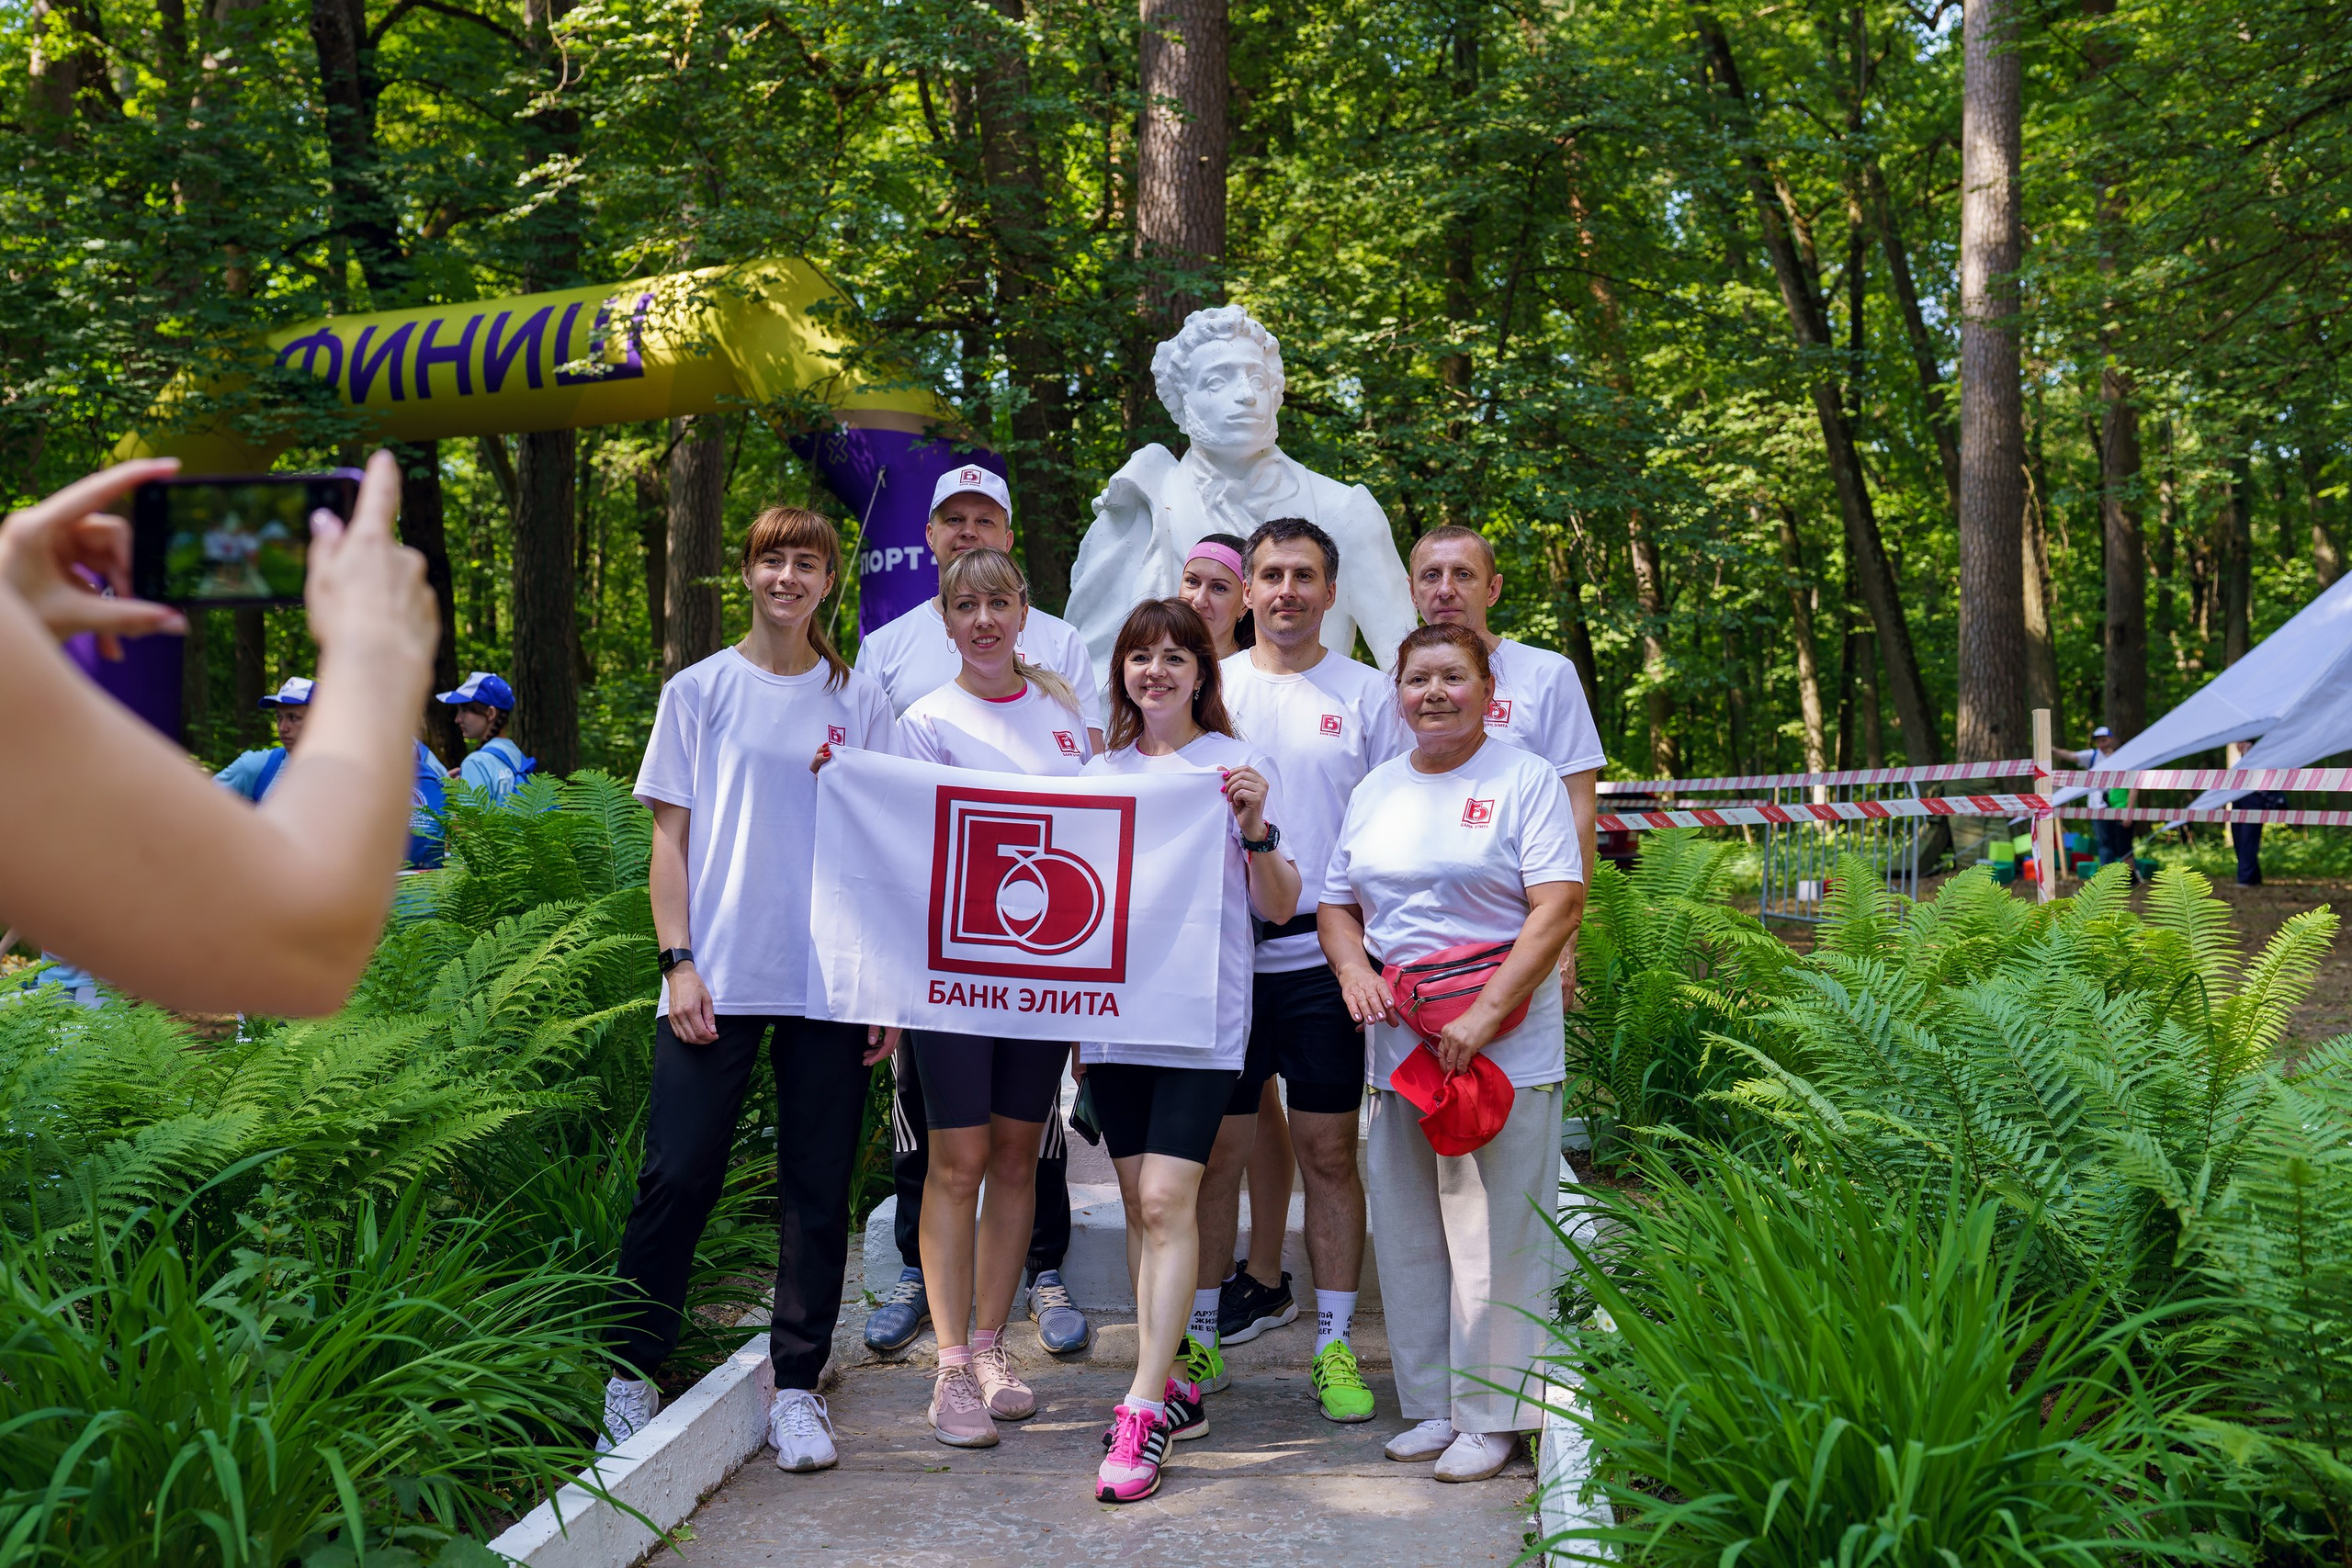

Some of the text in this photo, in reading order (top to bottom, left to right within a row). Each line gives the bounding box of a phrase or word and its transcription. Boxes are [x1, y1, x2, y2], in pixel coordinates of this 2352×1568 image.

[275, 292, 654, 405] ФИНИШ
[928, 980, 1120, 1017] БАНК ЭЛИТА
